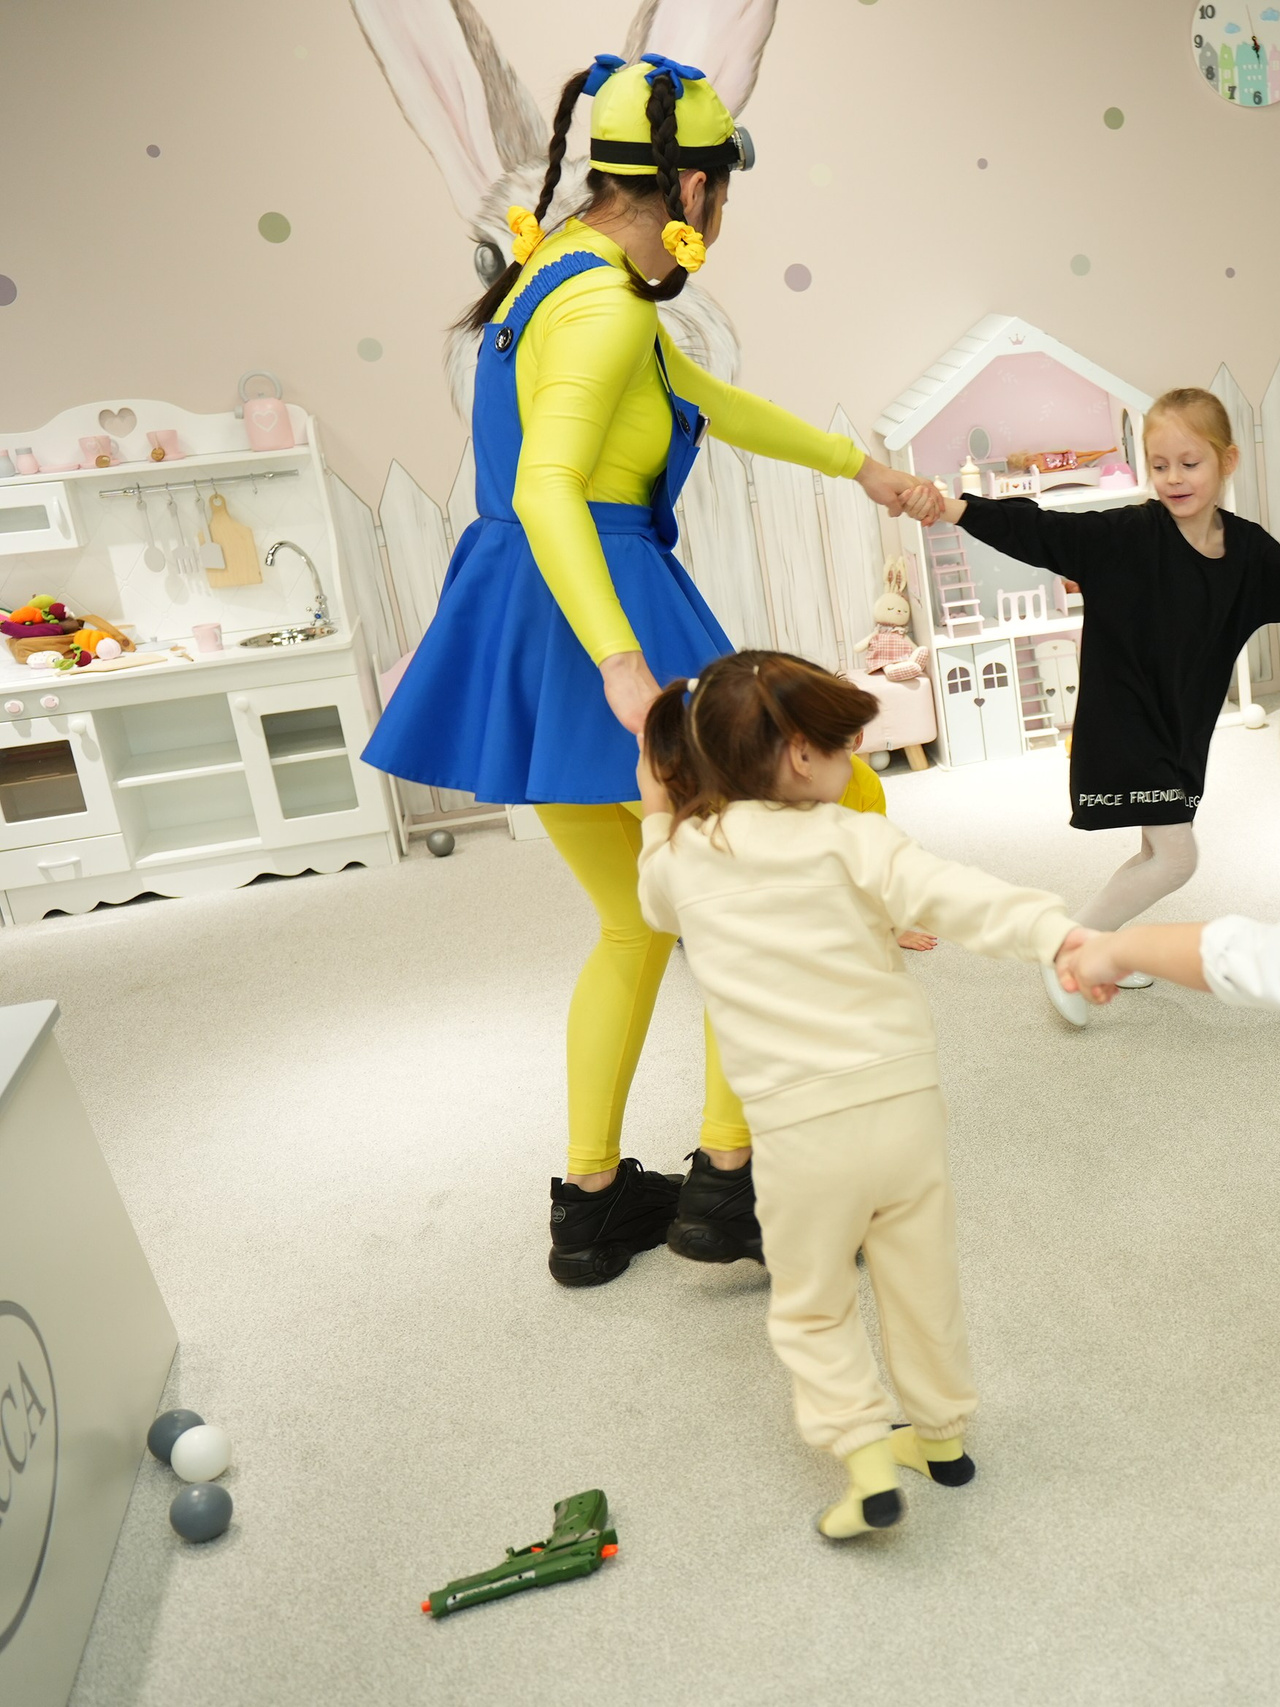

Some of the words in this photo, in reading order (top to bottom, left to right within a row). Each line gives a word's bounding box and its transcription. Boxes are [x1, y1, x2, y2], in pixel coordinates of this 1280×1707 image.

[1199, 4, 1216, 19] 10
[1193, 34, 1203, 48] 9
[1205, 65, 1215, 80] 8
[1227, 85, 1237, 99] 7
[1253, 91, 1262, 105] 6
[1079, 793, 1123, 807] PEACE
